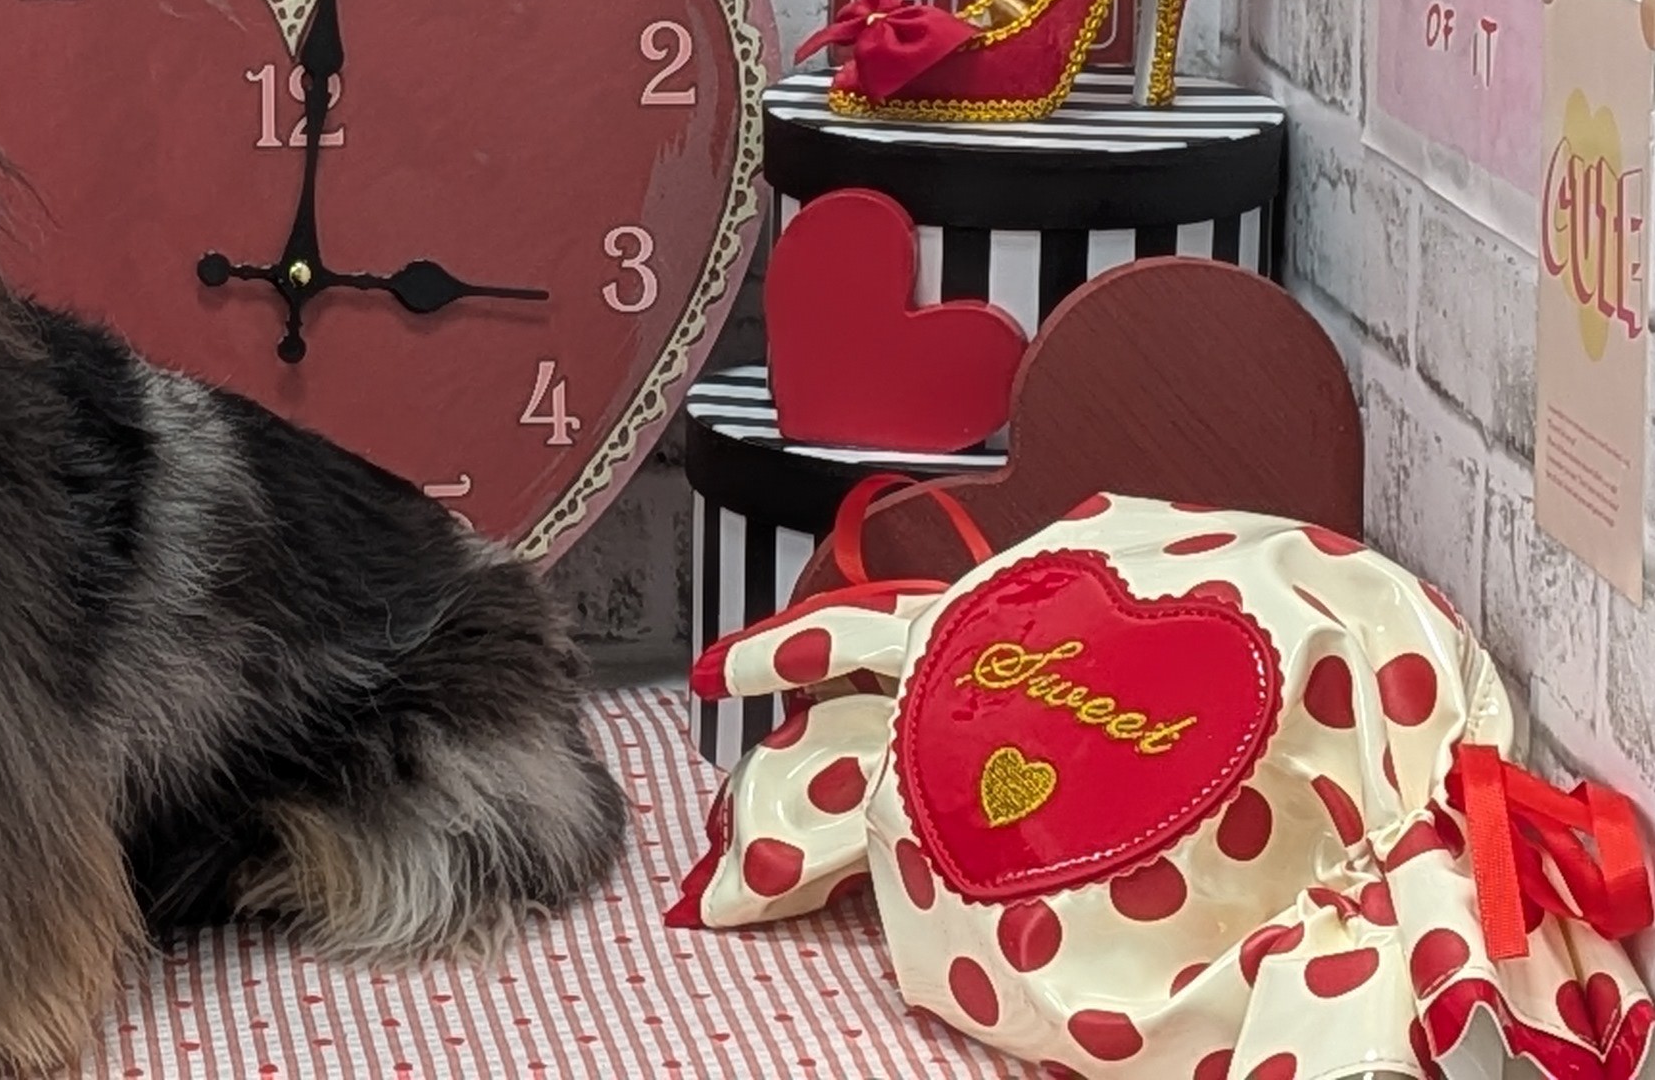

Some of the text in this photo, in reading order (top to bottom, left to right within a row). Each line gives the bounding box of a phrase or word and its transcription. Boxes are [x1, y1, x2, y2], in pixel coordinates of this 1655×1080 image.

[639, 21, 697, 106] 2
[1427, 3, 1498, 87] OF IT
[246, 64, 345, 147] 12
[601, 226, 658, 312] 3
[1542, 136, 1643, 340] CUTE
[519, 361, 581, 446] 4
[955, 641, 1197, 754] Sweet
